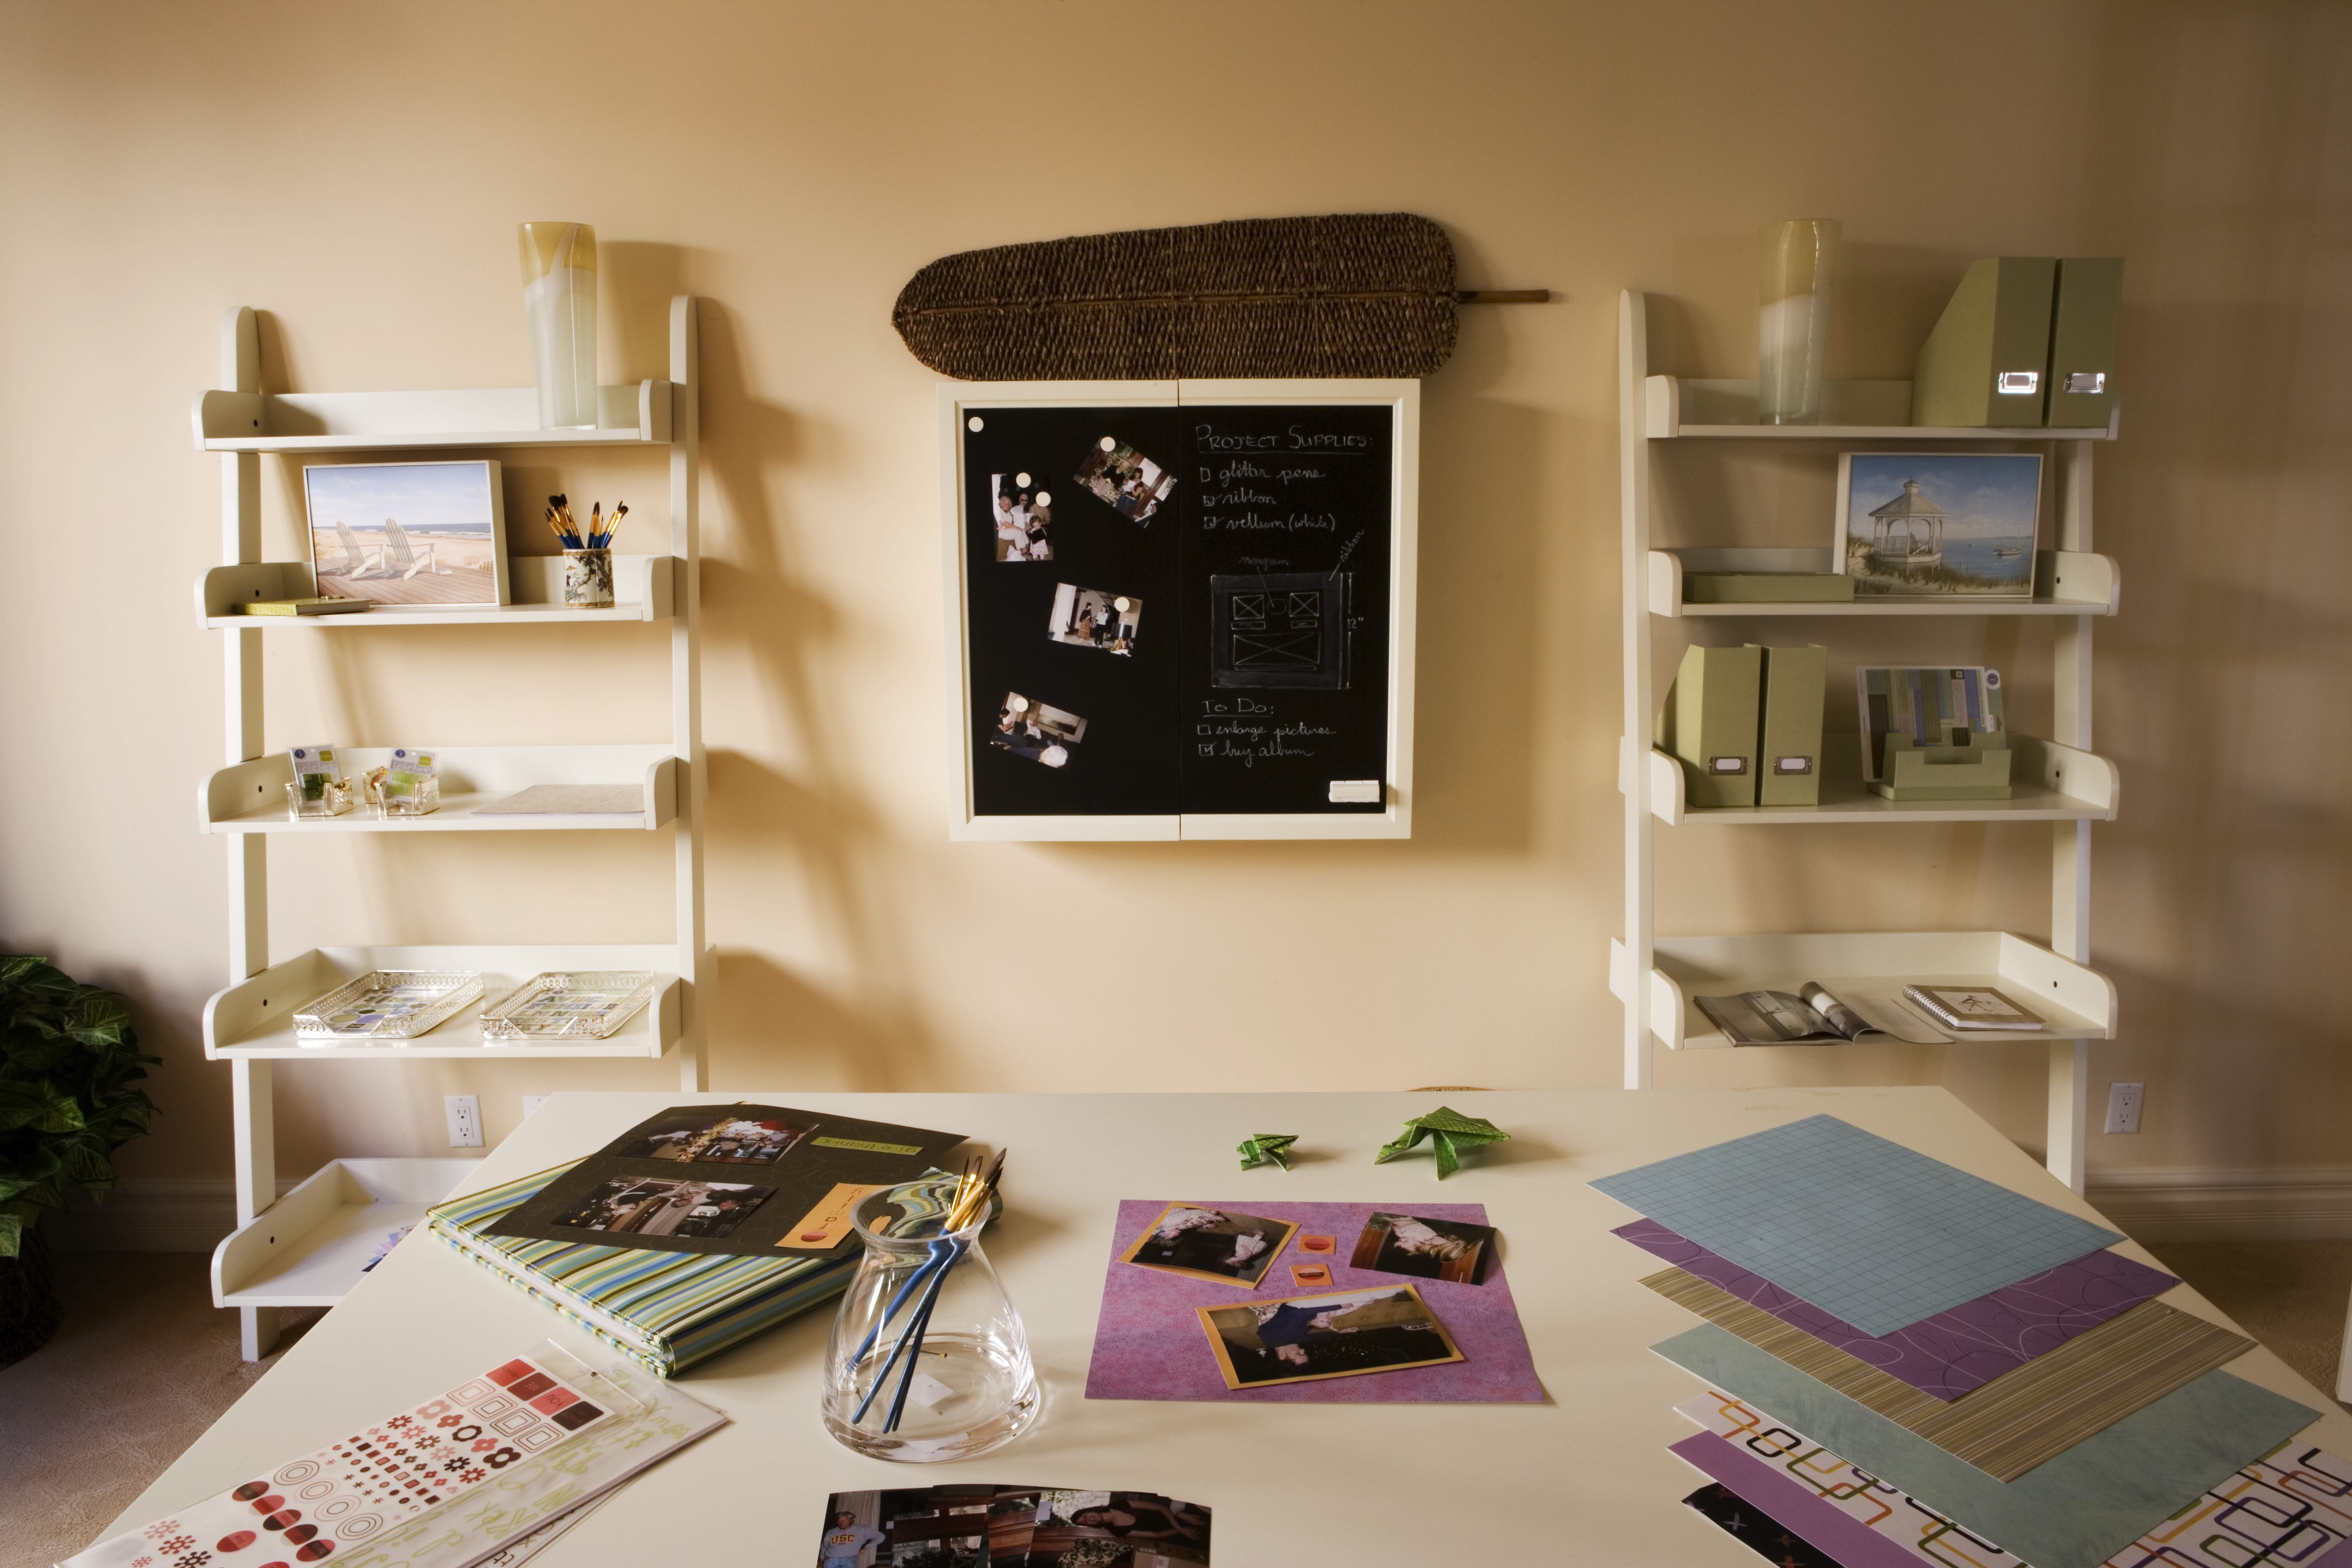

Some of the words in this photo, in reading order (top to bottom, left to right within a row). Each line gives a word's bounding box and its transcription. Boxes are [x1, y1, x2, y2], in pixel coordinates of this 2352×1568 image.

[1219, 460, 1271, 487] glitter
[1276, 468, 1326, 485] pens
[1222, 487, 1276, 504] ribbon
[1226, 512, 1285, 529] vellum
[1289, 513, 1336, 532] (white)
[1340, 529, 1364, 563] ribbon
[1201, 700, 1227, 714] To
[1238, 698, 1274, 714] Do:
[1216, 721, 1266, 742] enlarge
[1273, 722, 1337, 742] pictures
[1220, 741, 1255, 768] buy
[1258, 742, 1315, 757] album
[297, 761, 335, 773] icicles
[824, 1139, 876, 1150] thanks
[524, 1381, 541, 1392] ME
[544, 1393, 565, 1407] YOU
[831, 1534, 855, 1544] USC
